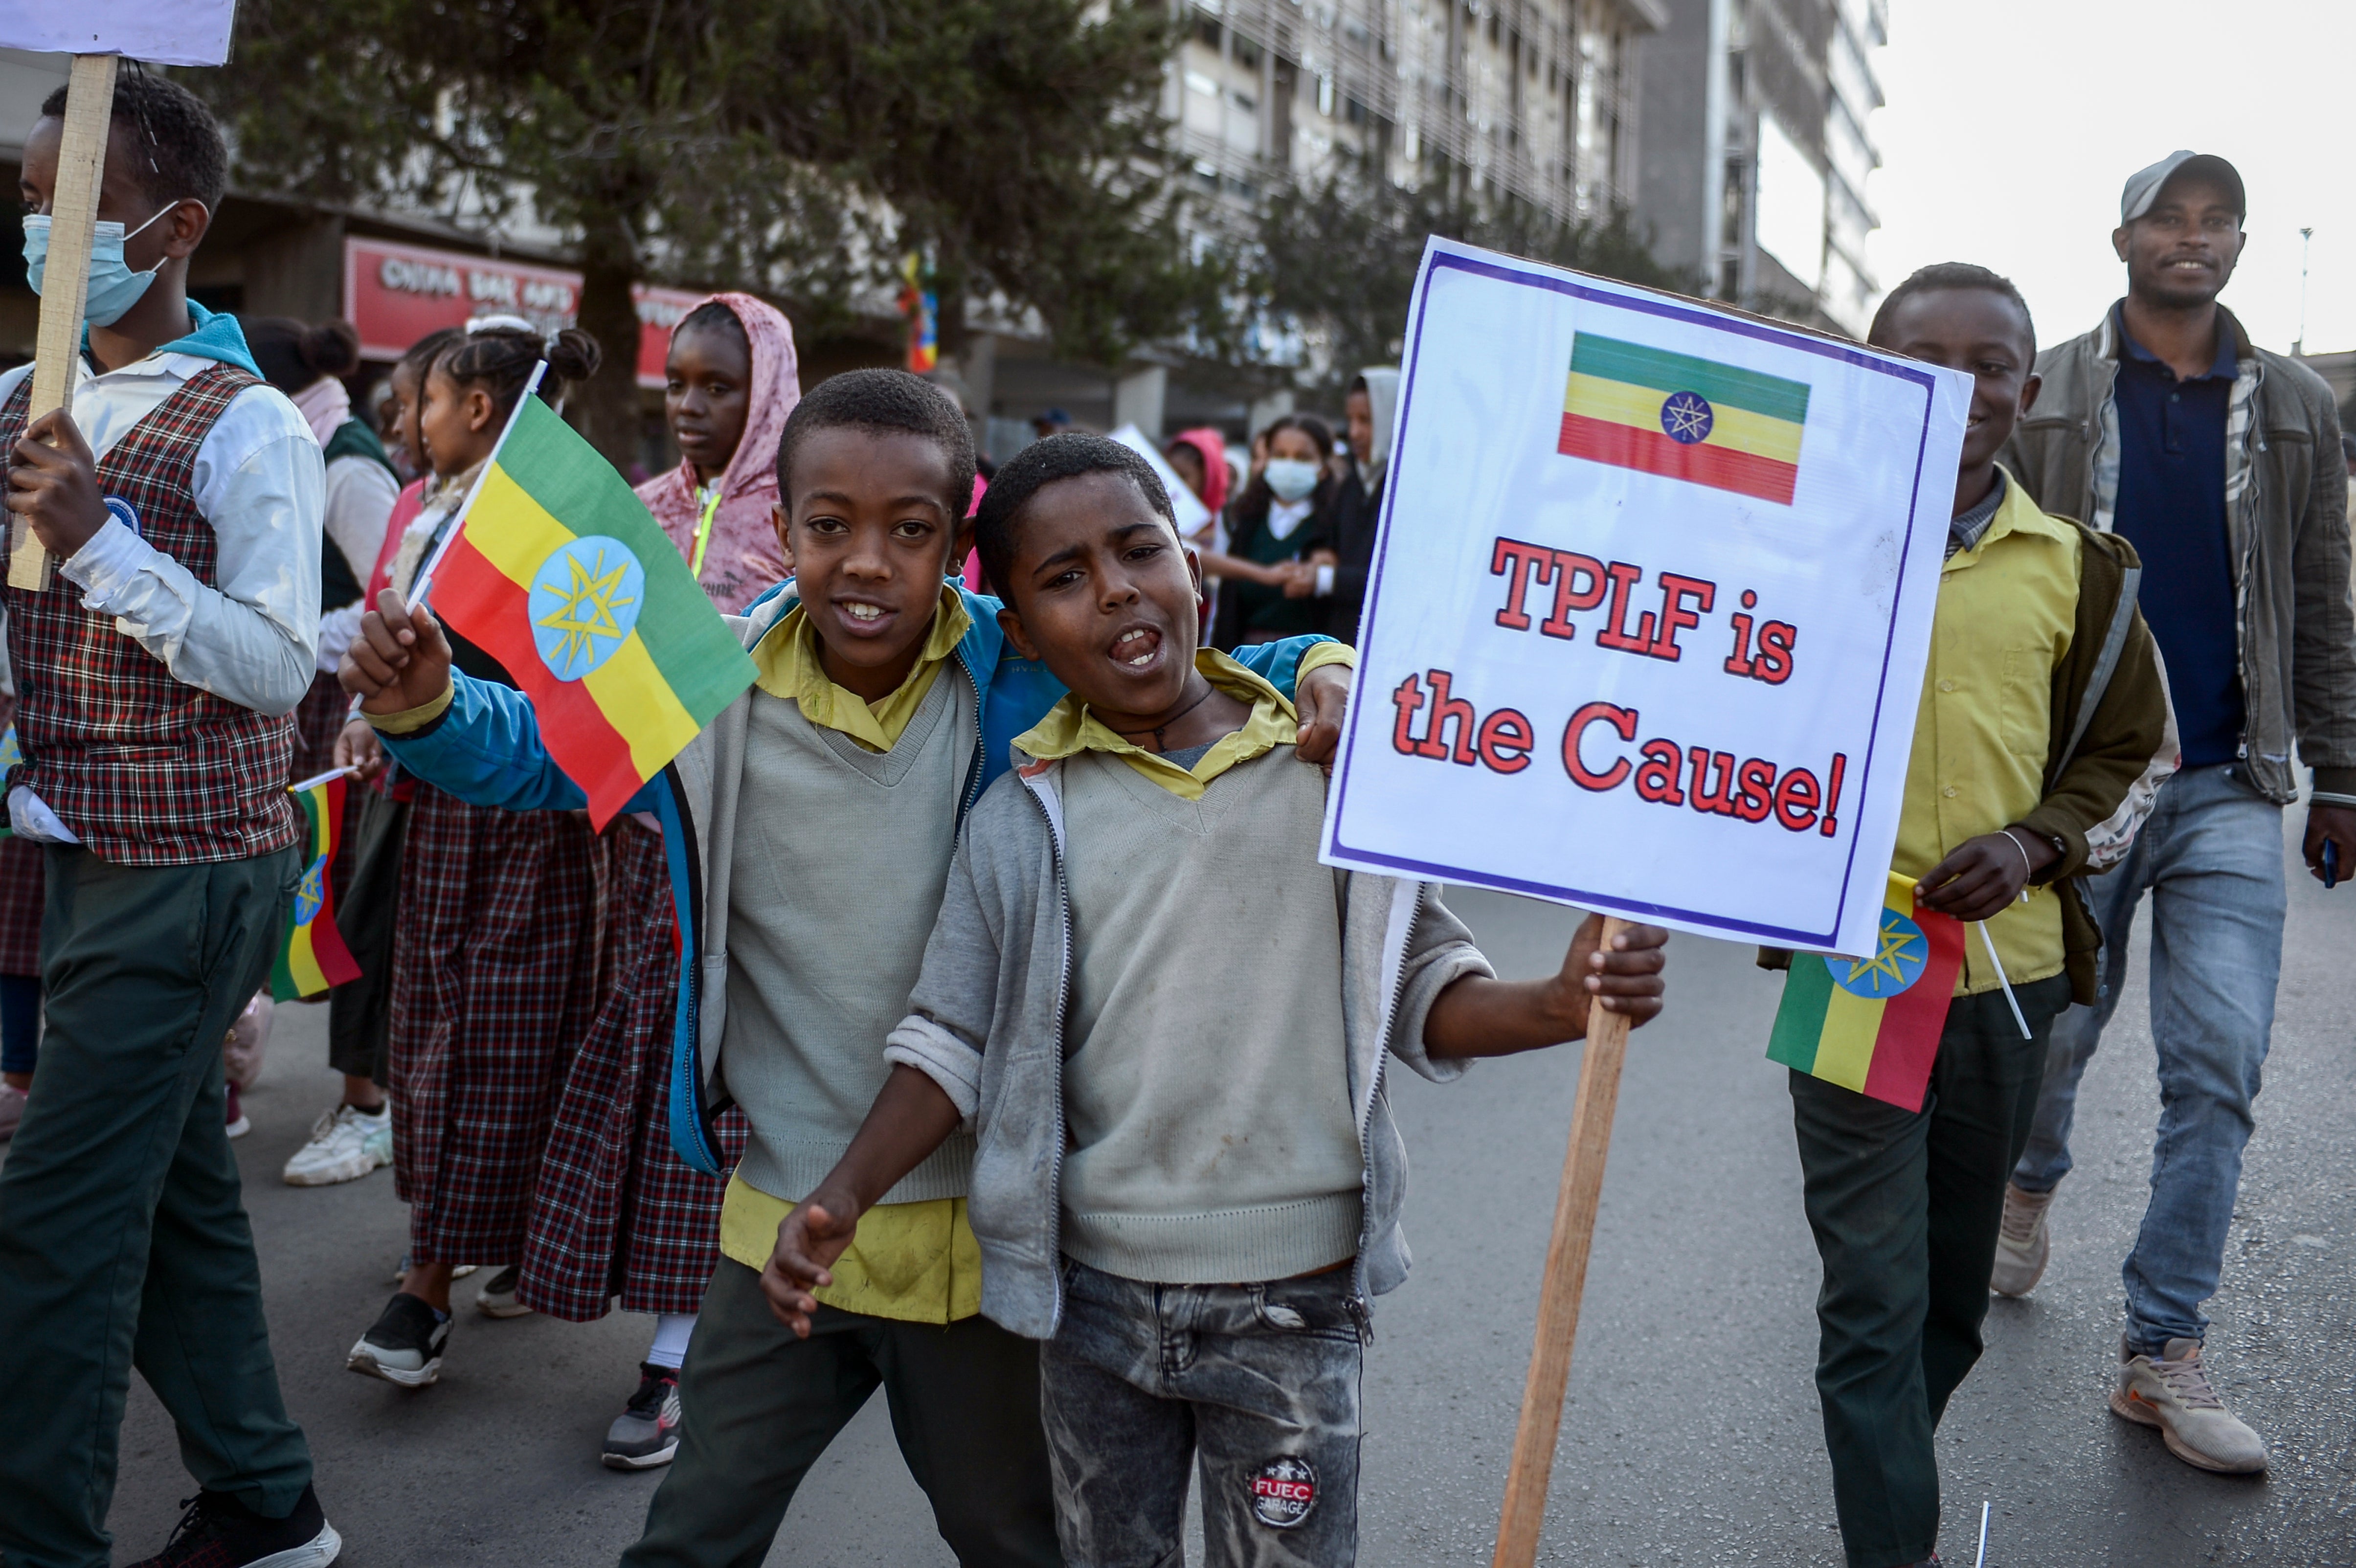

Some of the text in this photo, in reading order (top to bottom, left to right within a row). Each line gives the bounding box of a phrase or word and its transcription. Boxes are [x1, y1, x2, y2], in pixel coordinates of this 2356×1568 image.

[1491, 537, 1797, 685] TPLF is
[1392, 669, 1847, 838] the Cause!
[1256, 1479, 1309, 1500] FUEC
[1257, 1496, 1304, 1515] GARAGE
